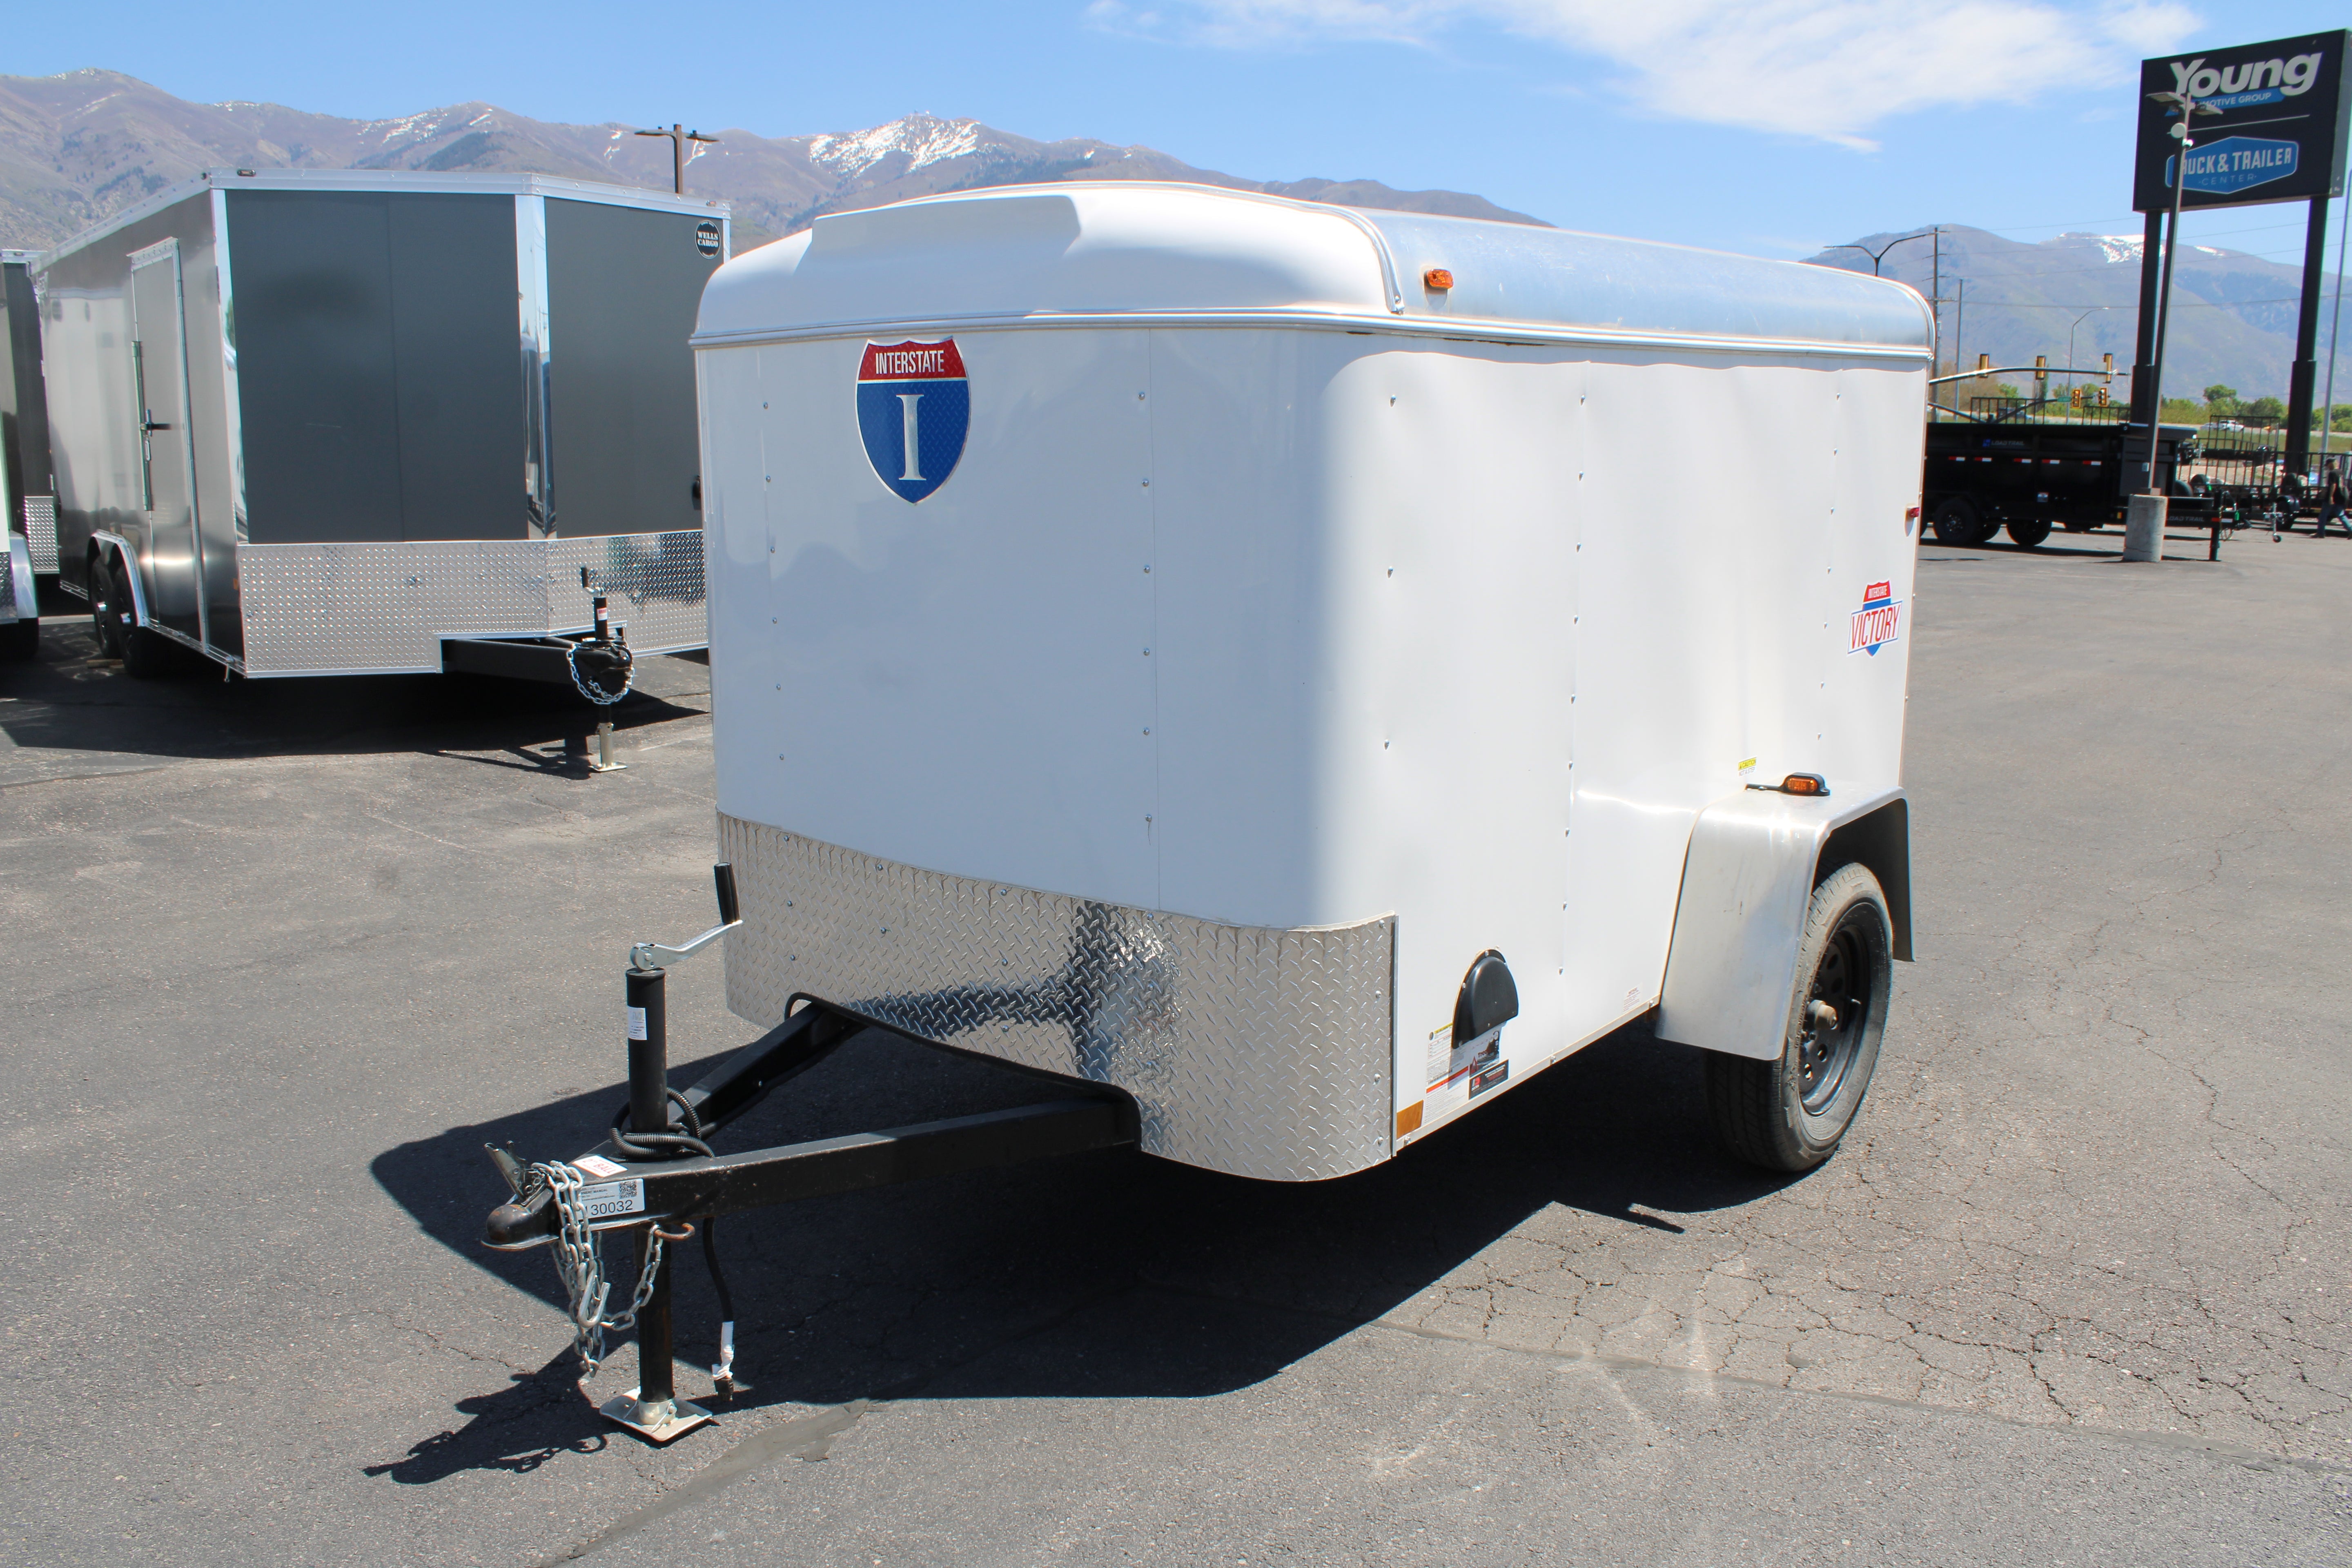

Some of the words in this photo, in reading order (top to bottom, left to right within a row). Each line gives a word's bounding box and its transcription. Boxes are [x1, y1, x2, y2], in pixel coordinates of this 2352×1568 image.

[2170, 52, 2322, 97] Young
[2238, 92, 2272, 102] GROUP
[2184, 155, 2215, 175] RUCK
[2217, 153, 2228, 173] &
[2232, 147, 2292, 171] TRAILER
[2201, 173, 2254, 185] CENTER
[697, 231, 718, 240] WELLS
[697, 239, 718, 247] CARGO
[875, 350, 944, 374] INTERSTATE
[1868, 585, 1888, 599] INTERSTATE
[1851, 604, 1901, 649] VICTORY
[1742, 759, 1756, 768] CAUTION
[593, 1163, 616, 1174] BALL
